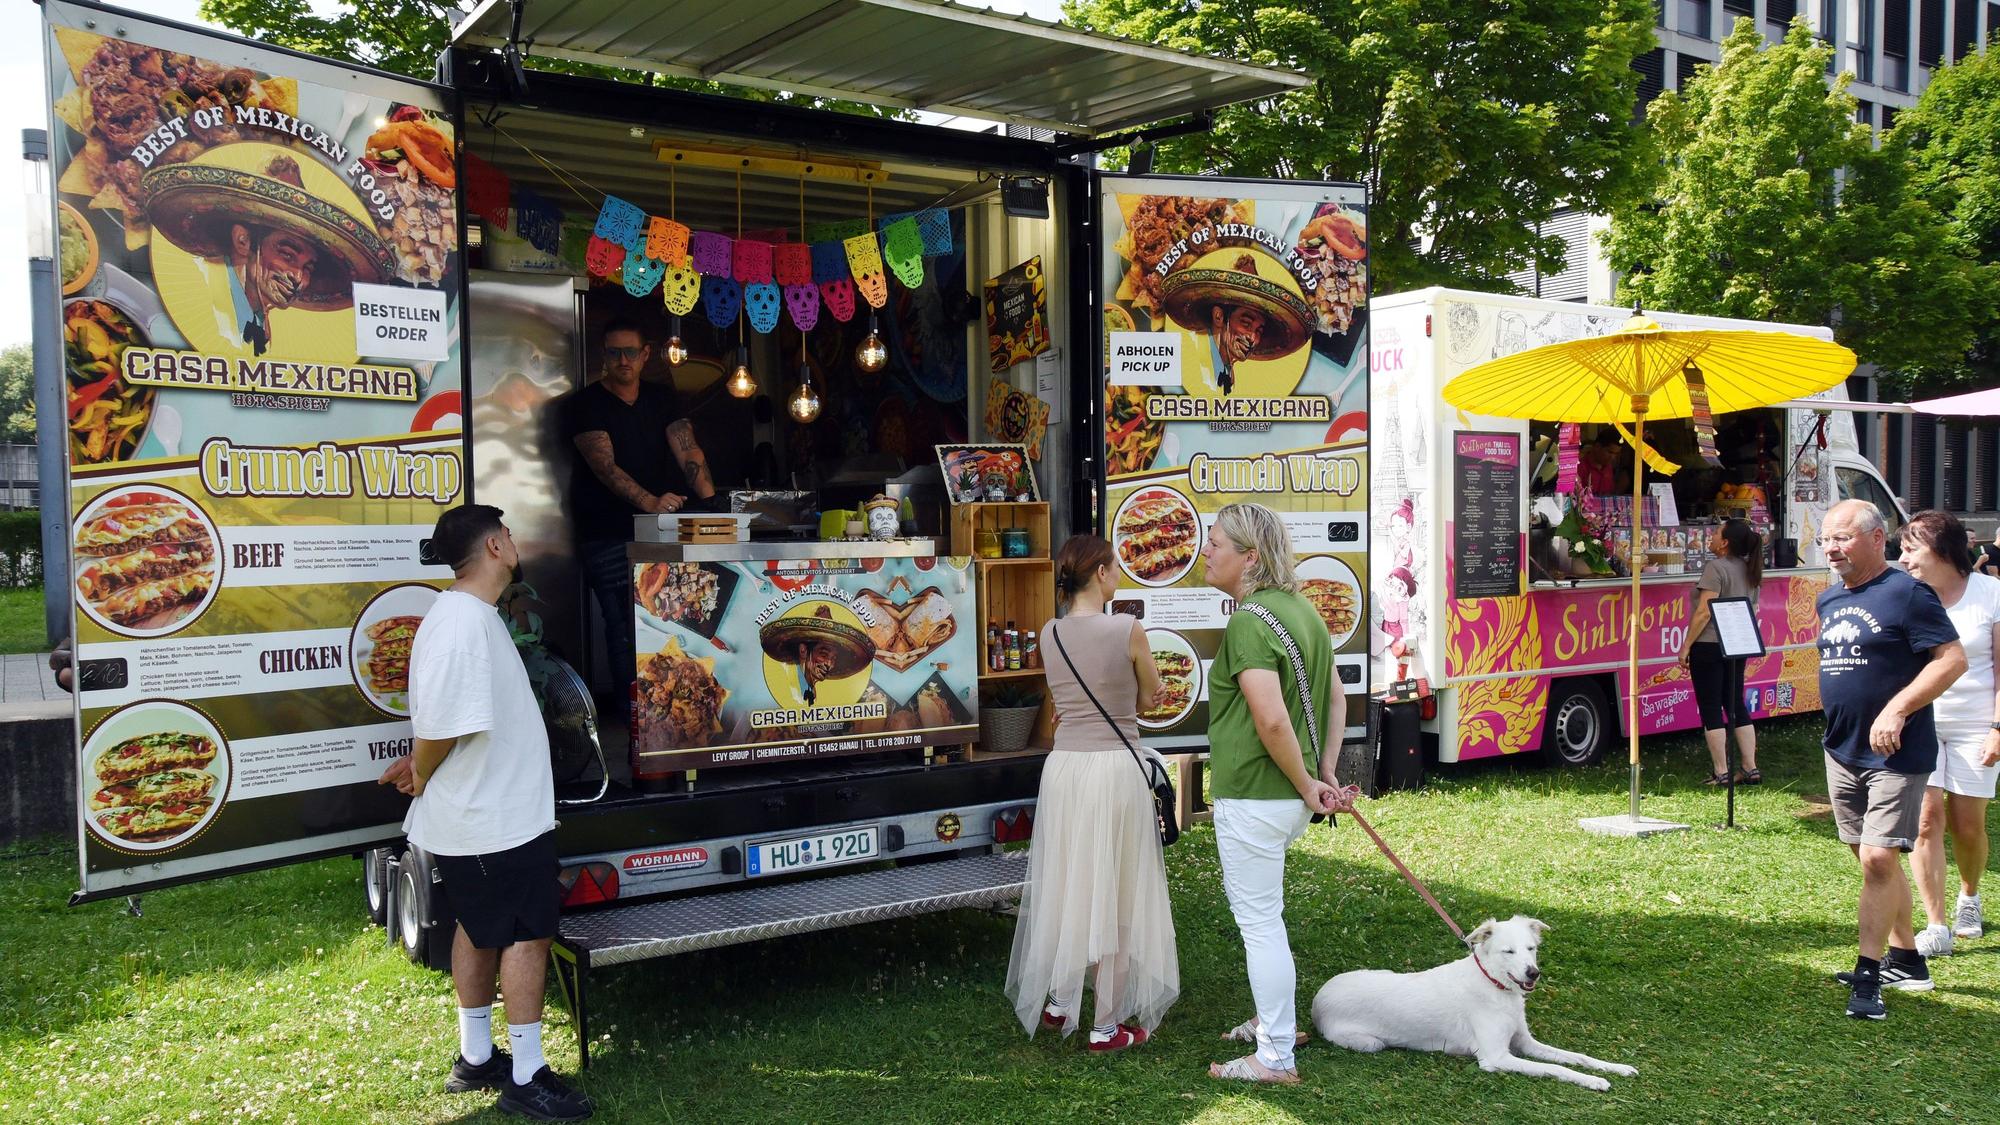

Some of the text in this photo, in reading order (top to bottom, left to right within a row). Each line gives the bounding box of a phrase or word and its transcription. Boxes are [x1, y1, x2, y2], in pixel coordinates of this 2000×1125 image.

[131, 105, 395, 221] BEST OF MEXICAN FOOD
[1155, 224, 1317, 290] BEST OF MEXICAN FOOD
[360, 303, 440, 323] BESTELLEN
[1003, 293, 1024, 311] MEXICAN
[1008, 306, 1021, 318] FOOD
[376, 326, 427, 342] ORDER
[1117, 346, 1174, 356] ABHOLEN
[1372, 348, 1403, 372] UCK
[126, 350, 414, 397] CASA MEXICANA
[1122, 362, 1170, 372] PICK UP
[1149, 399, 1326, 417] CASA MEXICANA
[202, 438, 461, 502] Crunch Wrap
[1191, 454, 1358, 495] Crunch Wrap
[232, 542, 284, 568] BEEF
[755, 584, 877, 628] BEST OF MEXICAN FOOD
[1554, 592, 1684, 660] SinThorn
[1834, 606, 1882, 634] BOROUGHS
[1661, 626, 1689, 654] FO
[260, 646, 342, 674] CHICKEN
[752, 704, 884, 726] CASA MEXICANA
[1642, 688, 1689, 717] Sawasdee
[368, 738, 414, 760] VEGGI
[713, 735, 921, 762] LEVY GROUP CHEMNITZERSTR. 1 63452 HANAU TEL. 0178 200 77 00
[632, 852, 700, 866] WÖRMANN
[772, 846, 800, 868] HU
[816, 840, 826, 862] I
[832, 832, 870, 858] 920
